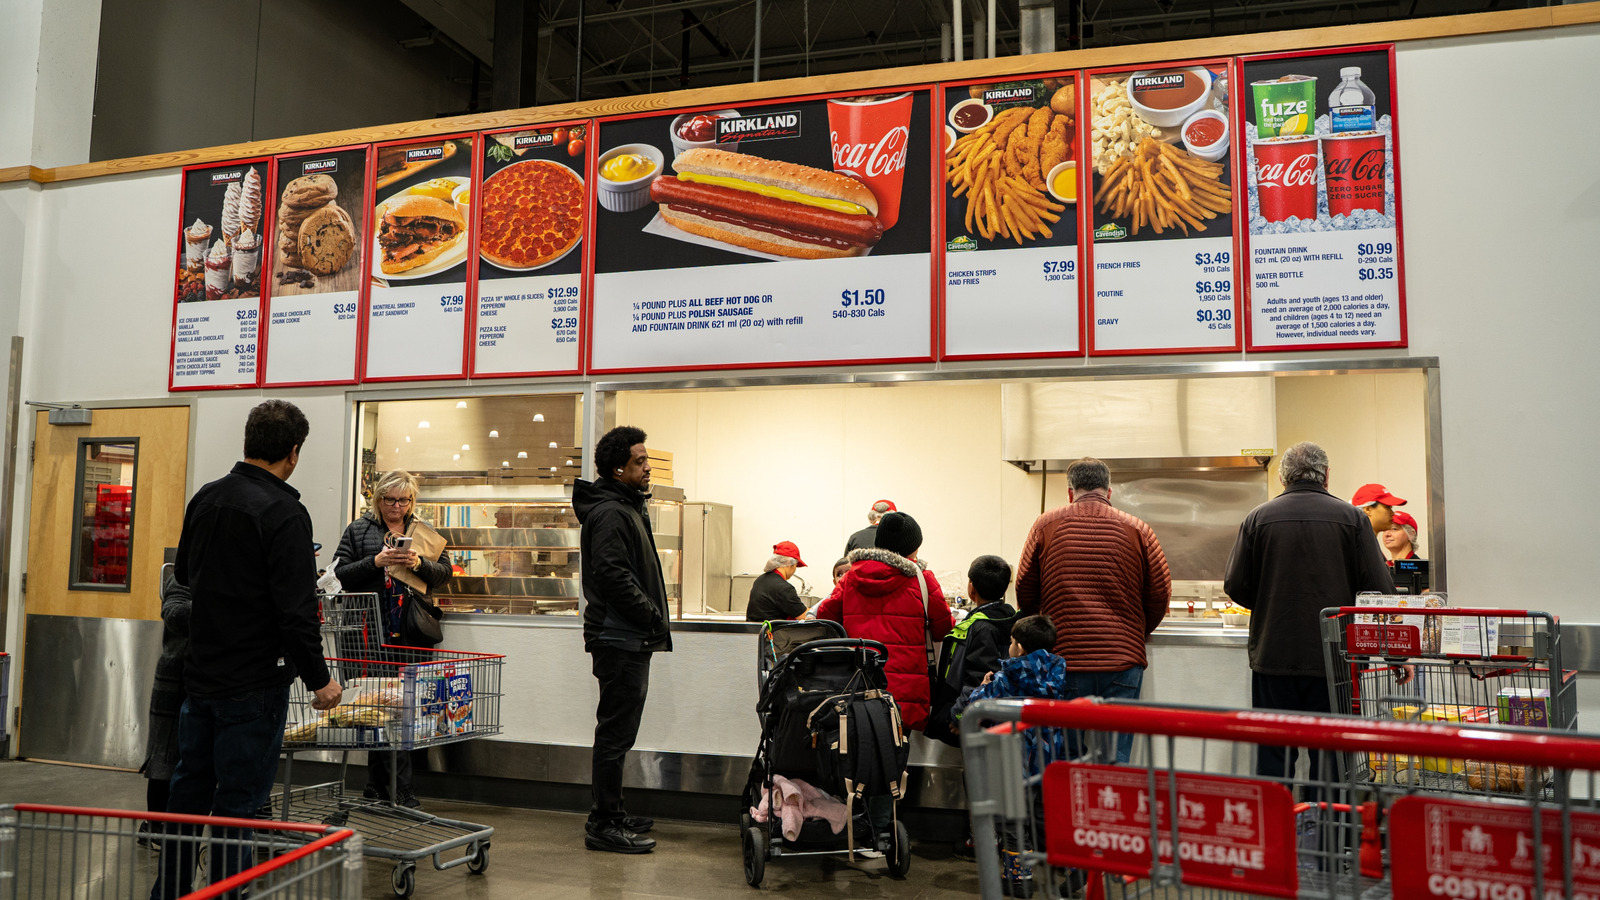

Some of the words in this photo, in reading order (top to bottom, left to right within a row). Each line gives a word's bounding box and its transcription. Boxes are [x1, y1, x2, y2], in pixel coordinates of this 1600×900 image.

[1135, 76, 1183, 87] KIRKLAND
[985, 88, 1032, 100] KIRKLAND
[1261, 99, 1307, 117] fuze
[721, 115, 798, 133] KIRKLAND
[516, 135, 552, 145] KIRKLAND
[721, 129, 797, 143] Signature
[409, 149, 442, 157] KIRKLAND
[305, 161, 336, 170] KIRKLAND
[212, 172, 241, 180] KIRKLAND
[1095, 229, 1125, 238] Cavendish
[948, 242, 977, 250] Cavendish
[1358, 243, 1392, 256] $0.99
[1196, 252, 1230, 266] $3.49
[1044, 261, 1074, 274] $7.99
[1359, 268, 1393, 281] $0.35
[548, 287, 578, 299] $12.99
[1196, 281, 1230, 294] $6.99
[441, 295, 463, 307] $7.99
[642, 301, 666, 309] POUND
[669, 300, 687, 308] PLUS
[705, 298, 724, 306] BEEF
[727, 297, 741, 305] HOT
[744, 296, 759, 304] DOG
[762, 295, 772, 303] OR
[842, 289, 884, 308] $1.50
[334, 303, 356, 314] $3.49
[642, 312, 666, 320] POUND
[689, 310, 715, 318] POLISH
[718, 308, 753, 316] SAUSAGE
[833, 309, 865, 318] 540-830
[868, 309, 885, 317] Cals
[237, 310, 257, 320] $2.89
[1197, 309, 1231, 322] $0.30
[552, 318, 577, 329] $2.59
[650, 322, 685, 331] FOUNTAIN
[687, 321, 709, 329] DRINK
[740, 319, 751, 328] (20
[754, 319, 764, 327] oz)
[786, 317, 803, 325] refill
[235, 344, 255, 354] $3.49
[1074, 829, 1145, 854] COSTCO
